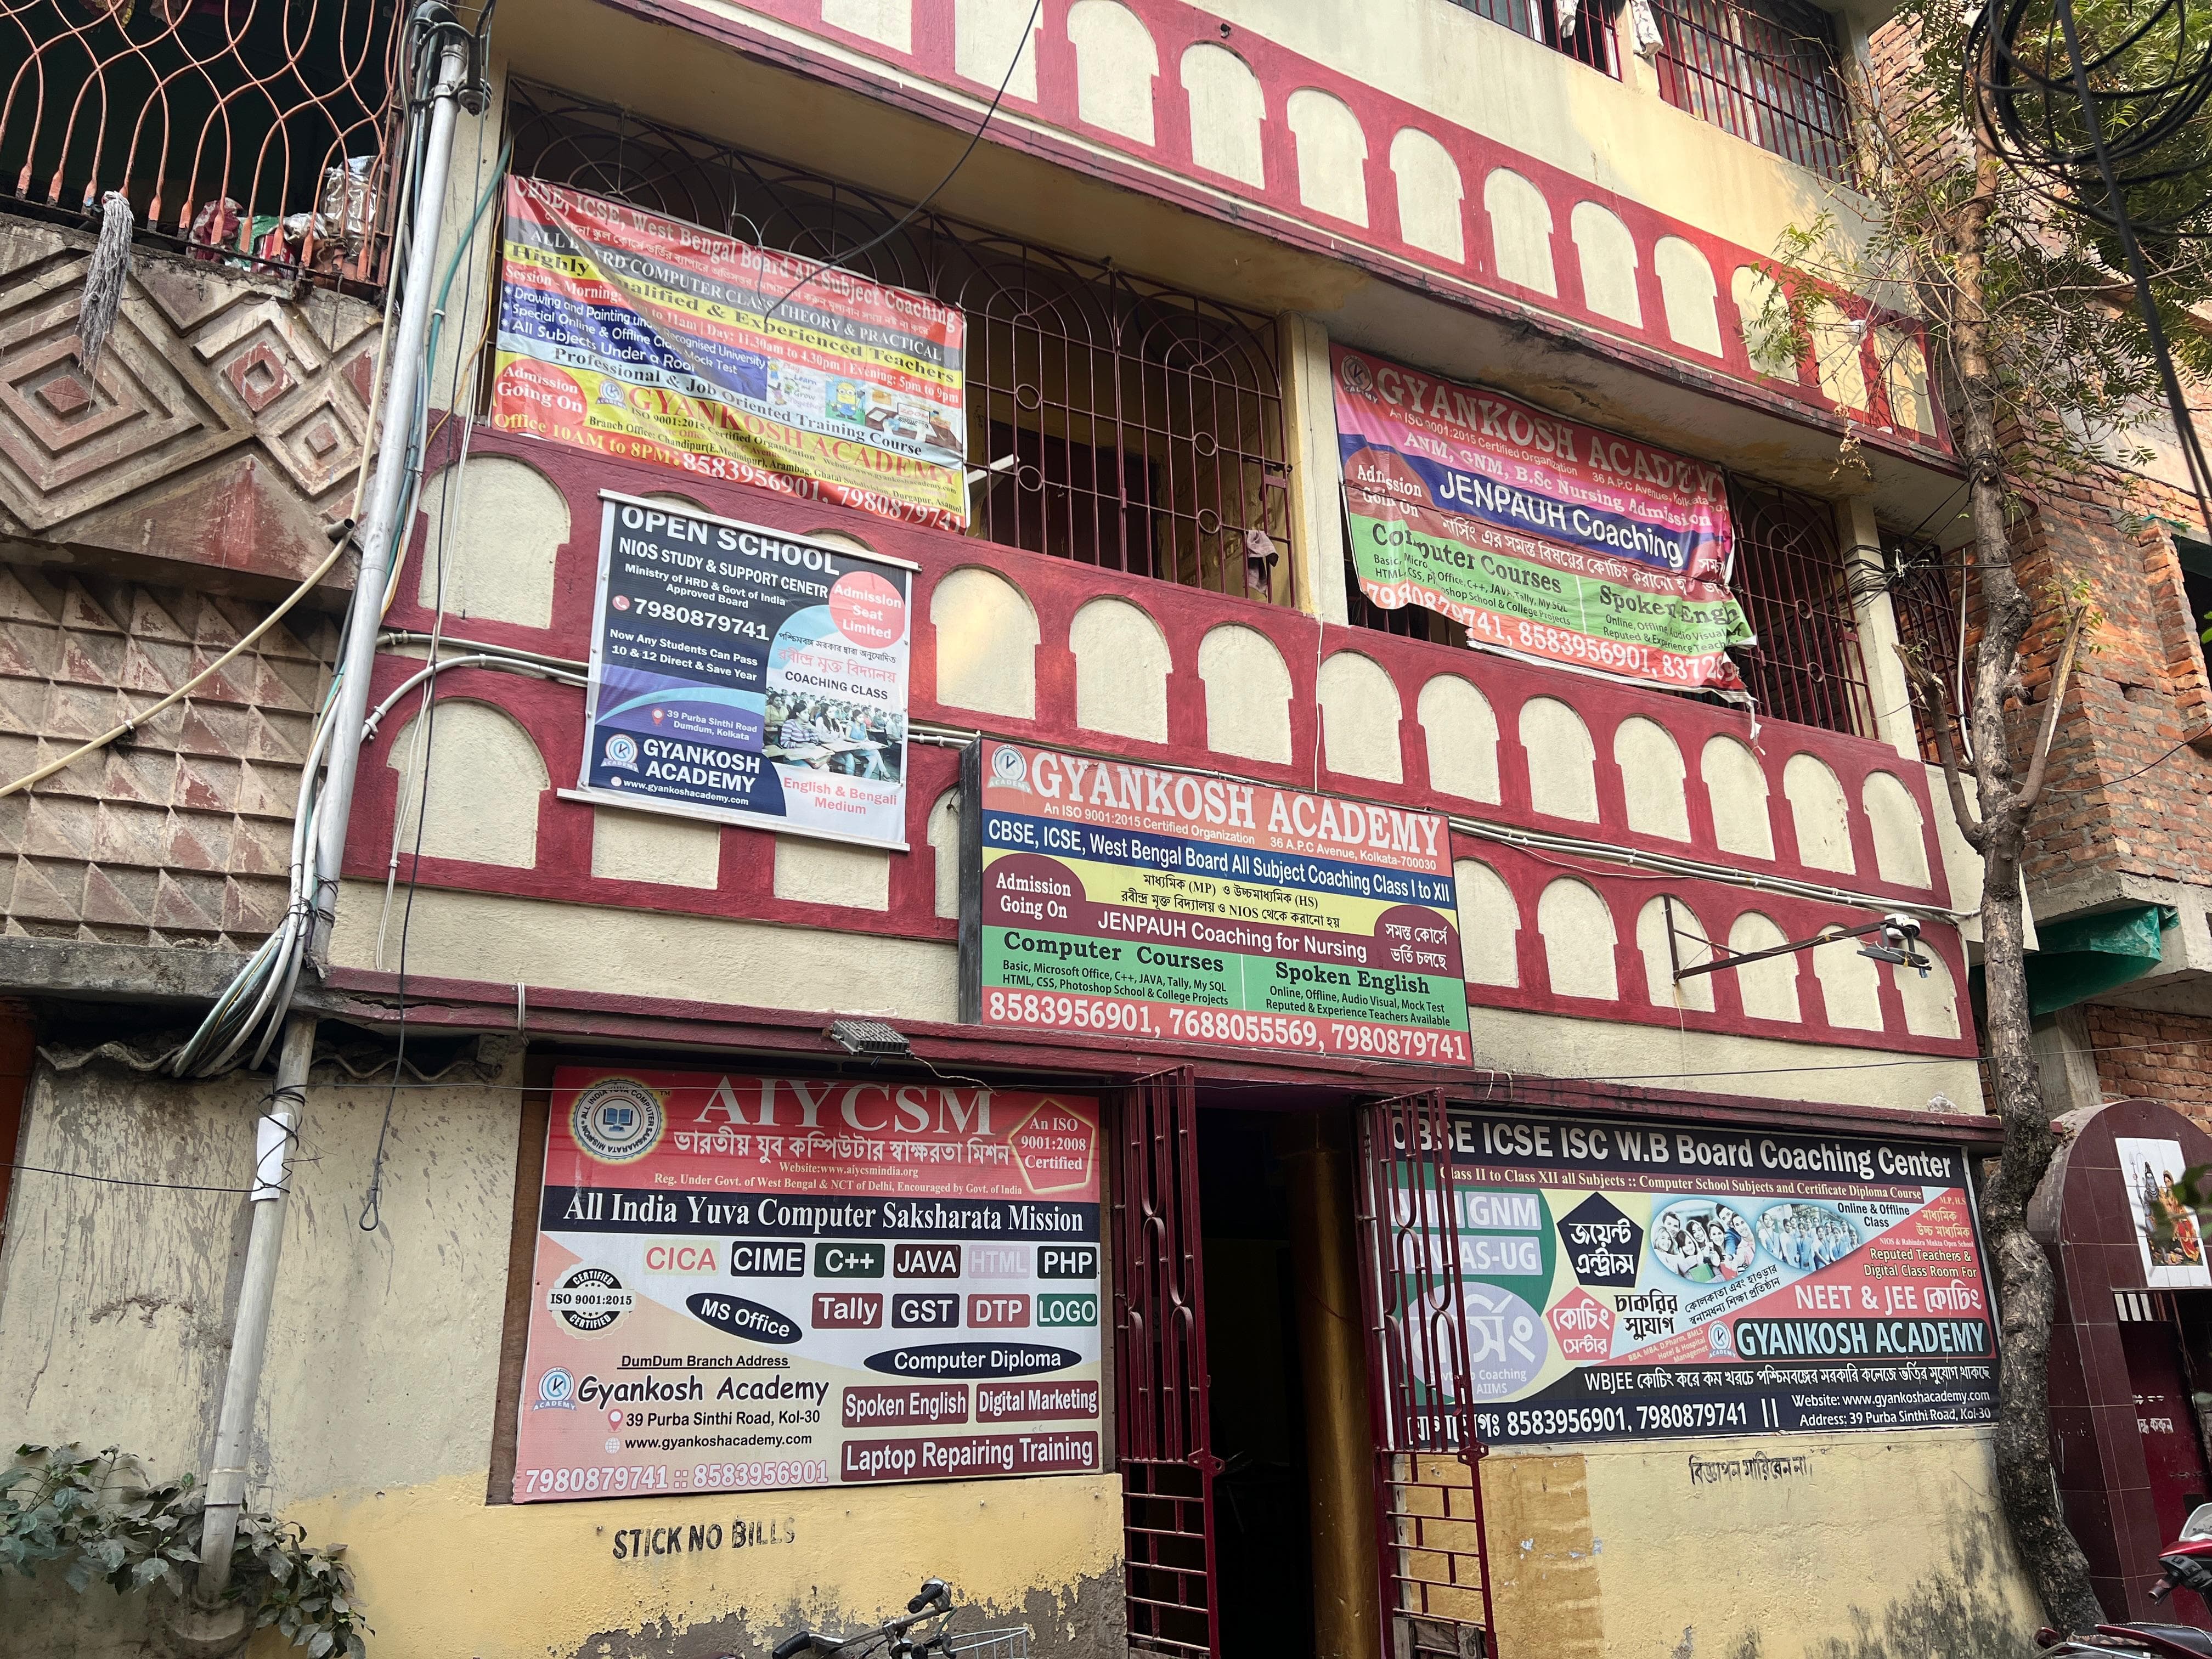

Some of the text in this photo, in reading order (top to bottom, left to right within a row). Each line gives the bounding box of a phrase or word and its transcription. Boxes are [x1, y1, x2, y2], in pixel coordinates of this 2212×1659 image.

[576, 195, 625, 230] ICSE,
[633, 213, 675, 242] West
[680, 226, 735, 264] Bengal
[741, 246, 788, 278] Board
[794, 262, 816, 286] All
[821, 270, 879, 305] Subject
[885, 289, 956, 332] Coaching
[512, 245, 954, 384] Highly ualified & Experienced Teachers
[503, 365, 579, 394] Admission
[498, 382, 583, 414] Going On
[1377, 368, 1577, 462] GYANKOSH
[629, 387, 955, 485] GYANKOSH ACADEMY
[494, 413, 961, 533] Office 10AM to 8PM: 8583956901, 7980879741
[1404, 432, 1712, 526] ANM, GNM, B.Sc Nursing Admission
[1440, 471, 1684, 568] JENPAUH Coaching
[620, 505, 840, 576] OPEN SCHOOL
[619, 537, 828, 599] NIOS STUDY & SUPPORT CENETR
[833, 583, 902, 610] Admission
[853, 604, 883, 622] Seat
[633, 598, 770, 641] 7980879741
[842, 619, 892, 640] Limited
[1520, 624, 1657, 679] 8583956901,
[785, 671, 888, 701] COACHING CLASS
[642, 738, 761, 774] GYANKOSH
[623, 778, 749, 806] www.gyankoshacademy.com
[646, 762, 756, 794] ACADEMY
[1031, 752, 1441, 856] GYANKOSH ACADEMY
[1044, 803, 1436, 871] An ISO 9001:2015 Certified Organization 36 A.P.C Avenue, Kolkata-700030
[989, 819, 1039, 849] CBSE,
[1044, 826, 1086, 856] ICSE,
[1090, 832, 1127, 857] West
[1132, 838, 1181, 867] Bengal
[1186, 844, 1228, 872] Board
[1254, 857, 1306, 887] Subject
[1308, 864, 1370, 895] Coaching
[1373, 874, 1408, 896] Class
[1411, 879, 1416, 895] I
[1418, 884, 1431, 900] to
[1434, 884, 1449, 902] XII
[996, 872, 1071, 898] Admission
[1000, 895, 1068, 921] Going On
[1004, 931, 1224, 972] Computer Courses
[989, 991, 1466, 1060] 8583956901, 7688055569, 7980879741
[693, 1075, 995, 1136] AIYCSM
[1030, 1117, 1078, 1131] An ISO
[673, 1125, 751, 1156] ভারতীয়
[756, 1135, 784, 1164] যুব
[967, 1137, 1010, 1165] মিশন
[1021, 1136, 1086, 1152] 9001:2008
[1483, 1122, 1553, 1158] ICSE
[1560, 1126, 1609, 1160] ISC
[1613, 1130, 1670, 1165] W.B
[1677, 1134, 1754, 1169] Board
[1760, 1139, 1872, 1180] Coaching
[1878, 1147, 1951, 1178] Center
[780, 1161, 918, 1179] Website:www.aiycsmindia.org
[1025, 1155, 1082, 1171] Certified
[563, 1192, 1084, 1234] All India Yuva Computer Saksharata Mission
[1837, 1201, 1910, 1216] Online & Offline
[1864, 1216, 1889, 1228] Class
[646, 1247, 1093, 1274] CICA CIME C++ JAVA HTML PHP
[1870, 1248, 1972, 1262] Reputed Teachers &
[551, 1293, 633, 1306] ISO 9001:2015
[817, 1296, 1097, 1325] Tally GST DTP LOGO
[1795, 1284, 1853, 1310] NEET
[1861, 1285, 1880, 1308] &
[1885, 1285, 1918, 1316] JEE
[701, 1299, 791, 1338] MS Office
[1737, 1322, 1985, 1357] GYANKOSH ACADEMY
[578, 1374, 830, 1410] Gyankosh Academy
[1791, 1391, 1990, 1408] Website: www.gyankoshacademy.com
[626, 1410, 820, 1427] 39 Purba Sinthi Road, Kol-30
[1506, 1402, 1747, 1437] 8583956901, 7980879741
[524, 1465, 668, 1494] 7980879741
[693, 1460, 828, 1489] 8583956901
[612, 1516, 795, 1559] STICK NO BILLS
